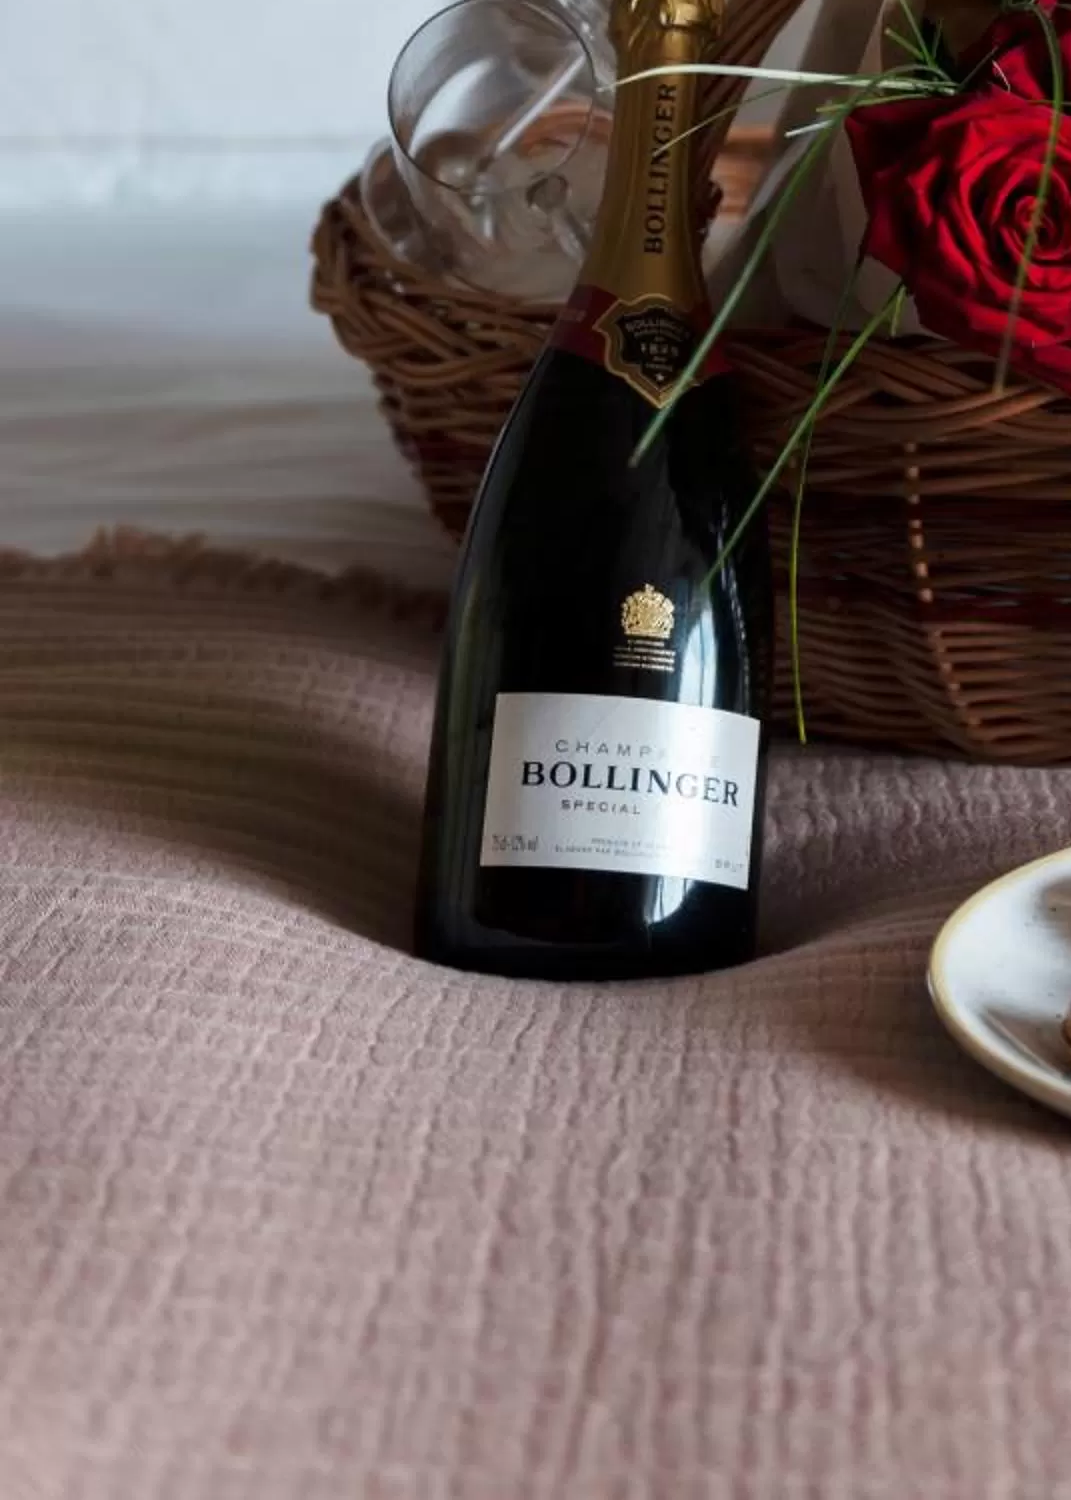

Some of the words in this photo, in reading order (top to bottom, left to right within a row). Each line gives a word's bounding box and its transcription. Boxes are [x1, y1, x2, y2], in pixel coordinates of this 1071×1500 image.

[643, 83, 678, 255] BOLLINGER
[521, 760, 739, 808] BOLLINGER
[560, 799, 642, 816] SPECIAL
